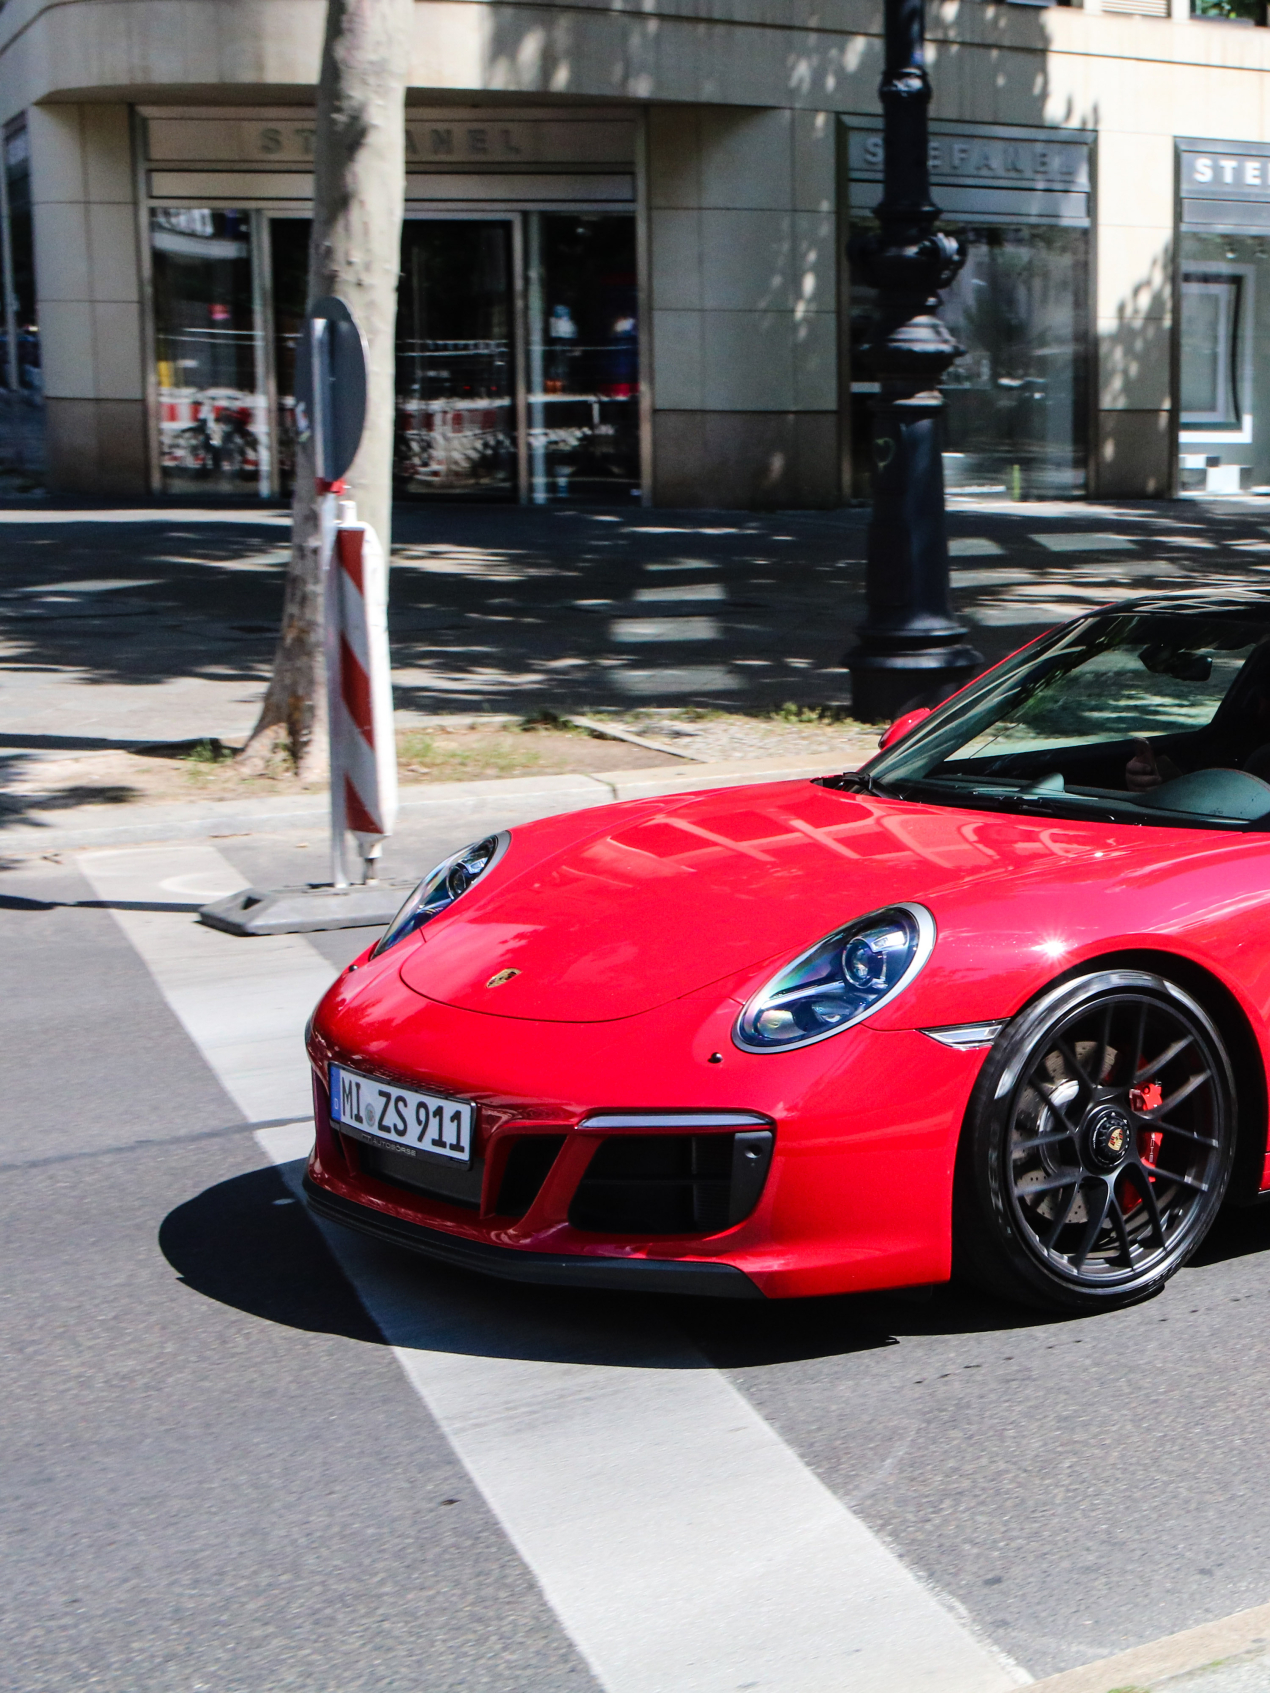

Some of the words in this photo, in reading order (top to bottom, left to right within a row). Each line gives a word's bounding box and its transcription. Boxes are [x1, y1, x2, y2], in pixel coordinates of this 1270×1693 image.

[863, 137, 1076, 176] SEFANEL
[341, 1076, 364, 1125] MI
[377, 1089, 408, 1138] ZS
[415, 1100, 465, 1154] 911
